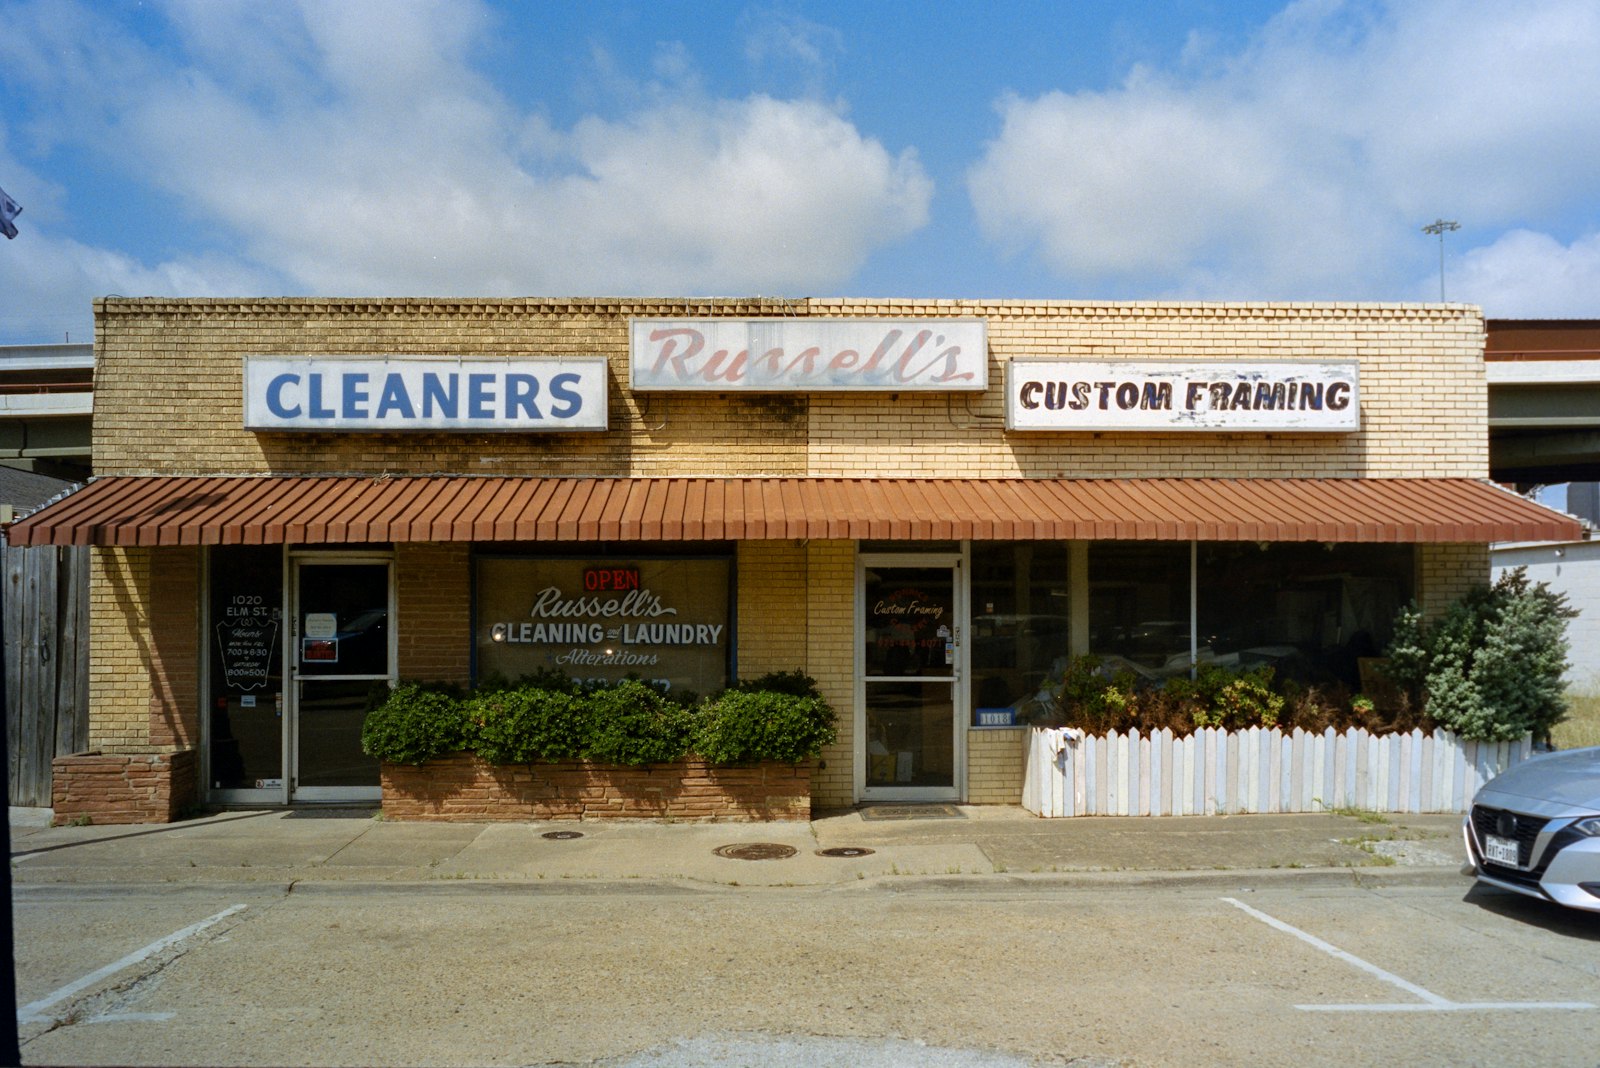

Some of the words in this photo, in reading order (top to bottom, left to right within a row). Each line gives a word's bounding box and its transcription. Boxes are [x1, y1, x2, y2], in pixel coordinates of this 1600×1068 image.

[649, 327, 975, 383] Russell's
[265, 372, 584, 420] CLEANERS
[1019, 381, 1173, 411] CUSTOM
[1185, 381, 1351, 411] FRAMING
[585, 570, 639, 591] OPEN
[232, 595, 263, 605] 1020
[531, 586, 677, 618] Russell's
[873, 600, 905, 615] Custom
[907, 600, 944, 619] Framing
[226, 607, 249, 616] ELM
[252, 607, 268, 616] ST.
[491, 622, 604, 644] CLEANING
[623, 624, 723, 644] LAUNDRY
[556, 649, 660, 666] Alterations
[984, 713, 1008, 724] 1018
